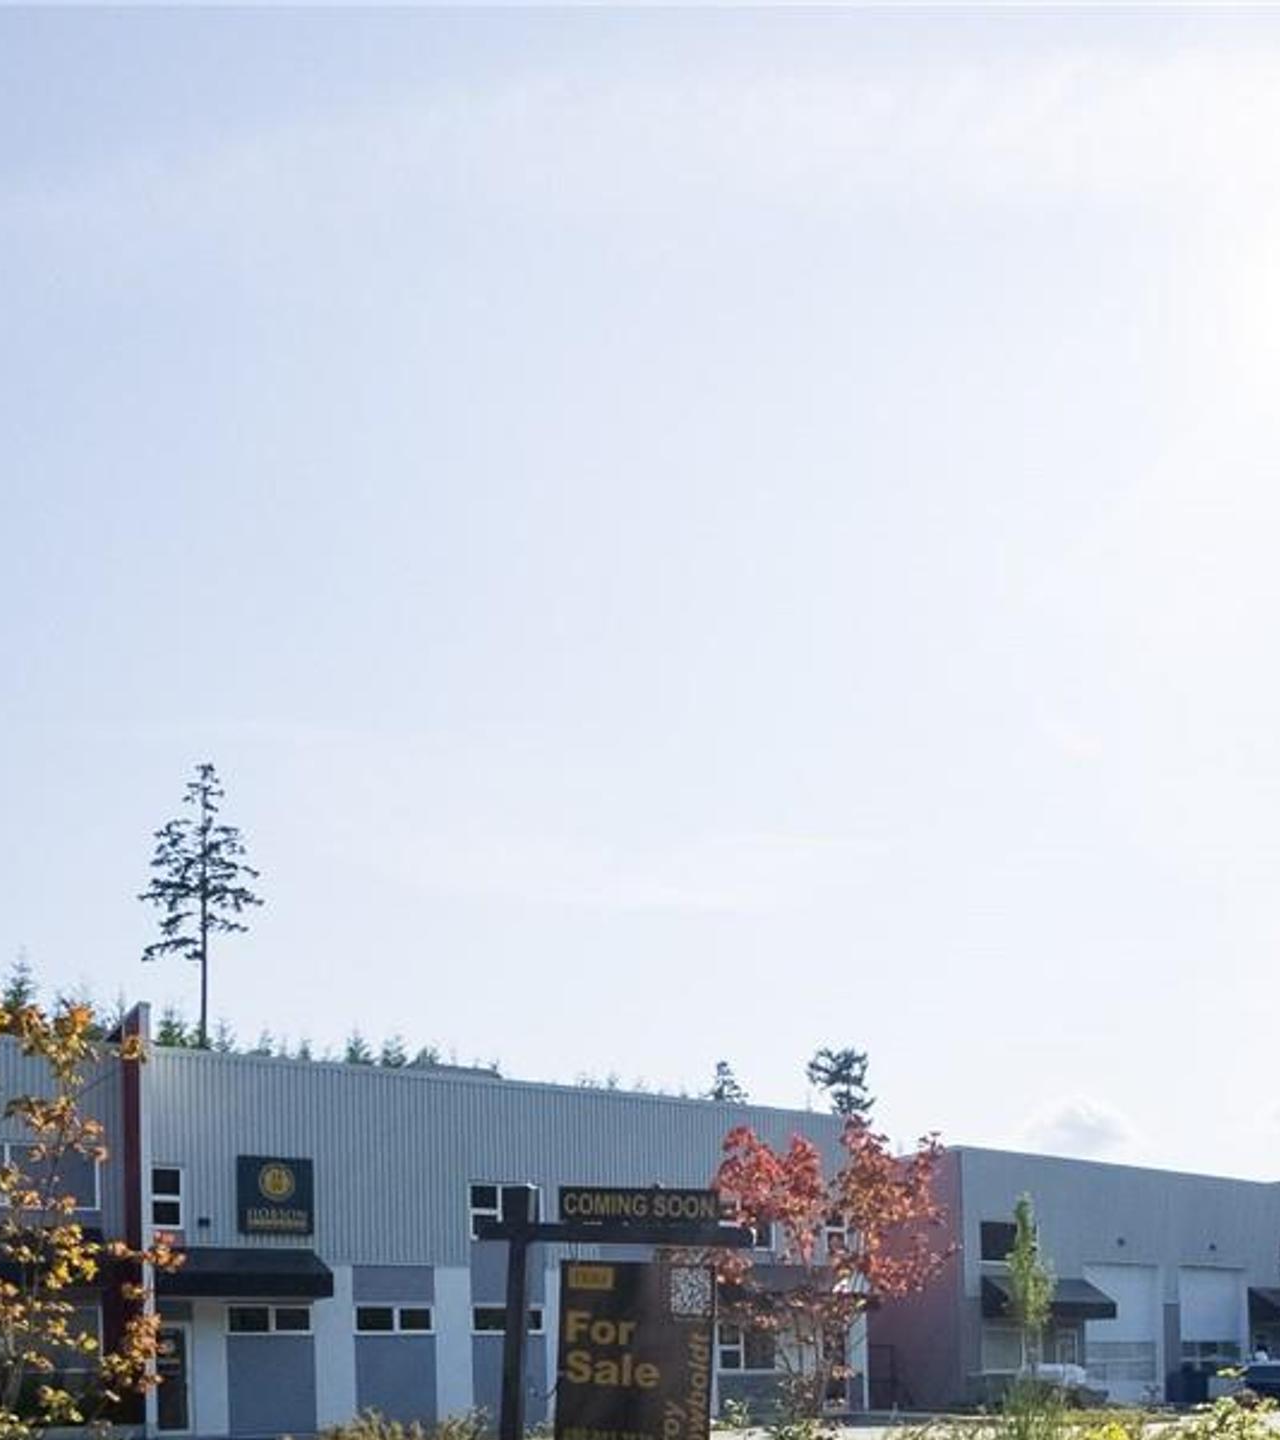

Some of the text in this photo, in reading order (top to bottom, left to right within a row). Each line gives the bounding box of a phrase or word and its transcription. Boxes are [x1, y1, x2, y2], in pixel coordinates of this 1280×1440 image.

[563, 1192, 715, 1219] COMING SOON
[566, 1310, 637, 1346] For
[566, 1351, 661, 1388] Sale
